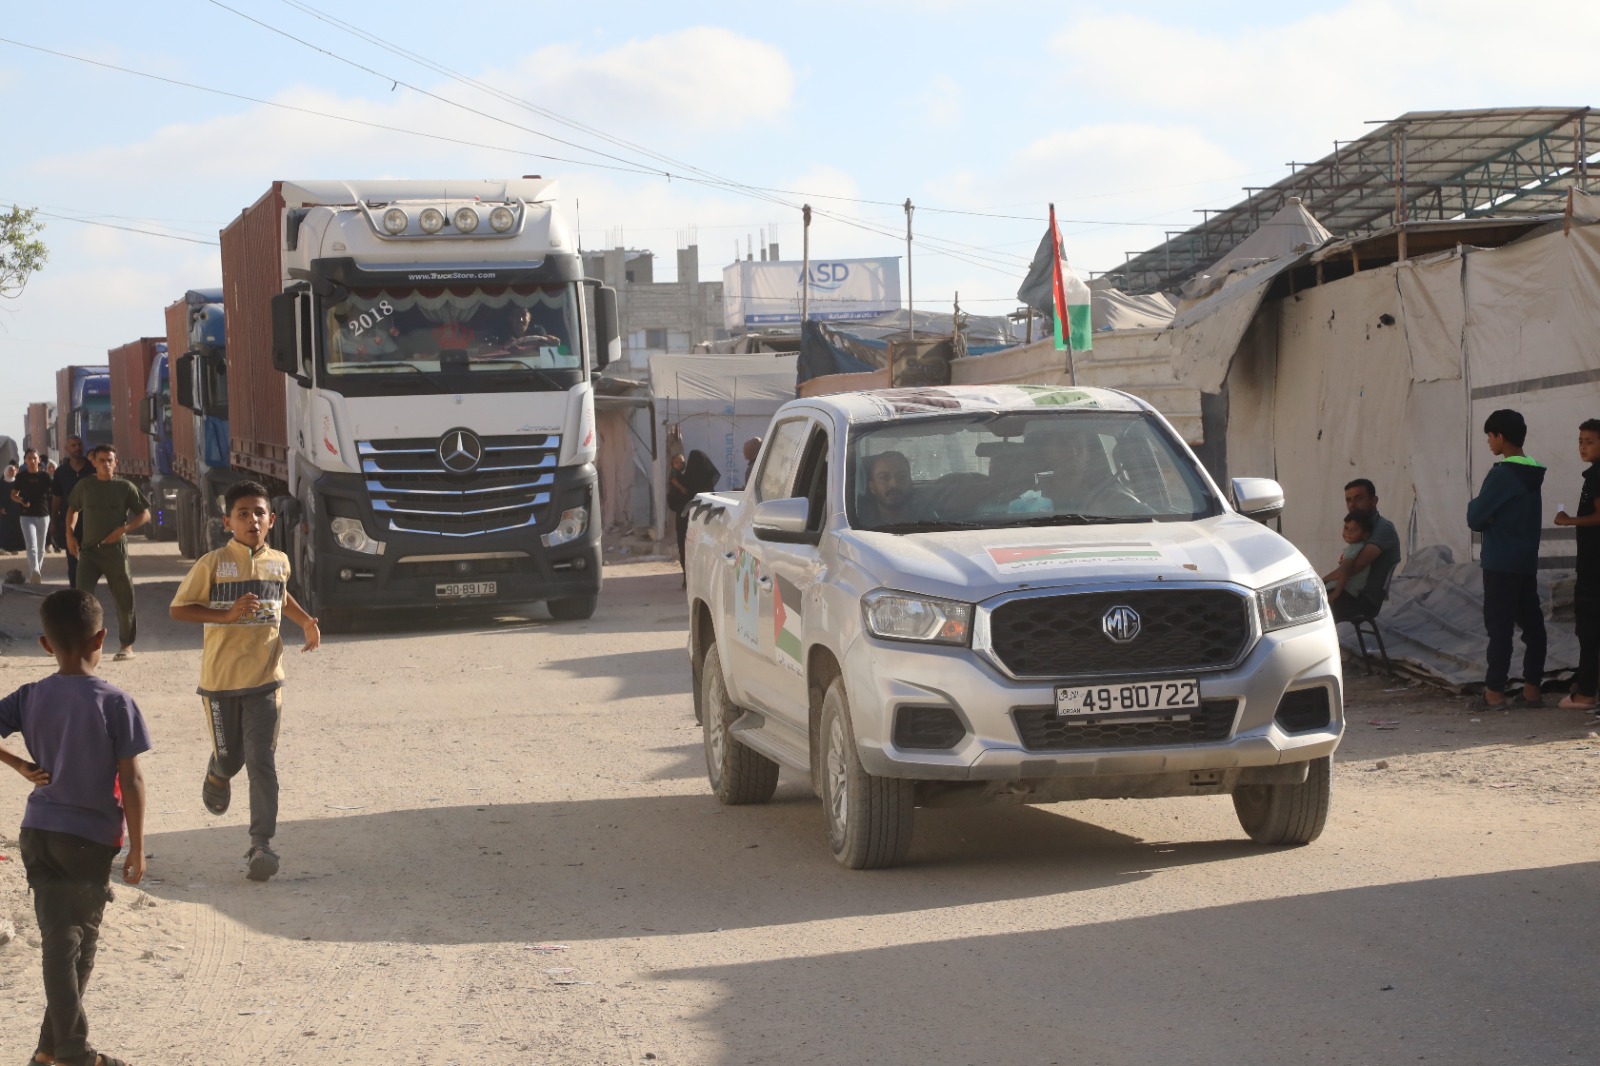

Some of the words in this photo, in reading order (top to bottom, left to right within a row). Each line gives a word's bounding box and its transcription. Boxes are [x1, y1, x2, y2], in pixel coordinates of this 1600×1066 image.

[798, 263, 850, 283] ASD
[348, 300, 394, 337] 2018
[1107, 608, 1138, 639] MG
[1082, 682, 1196, 712] 49-80722
